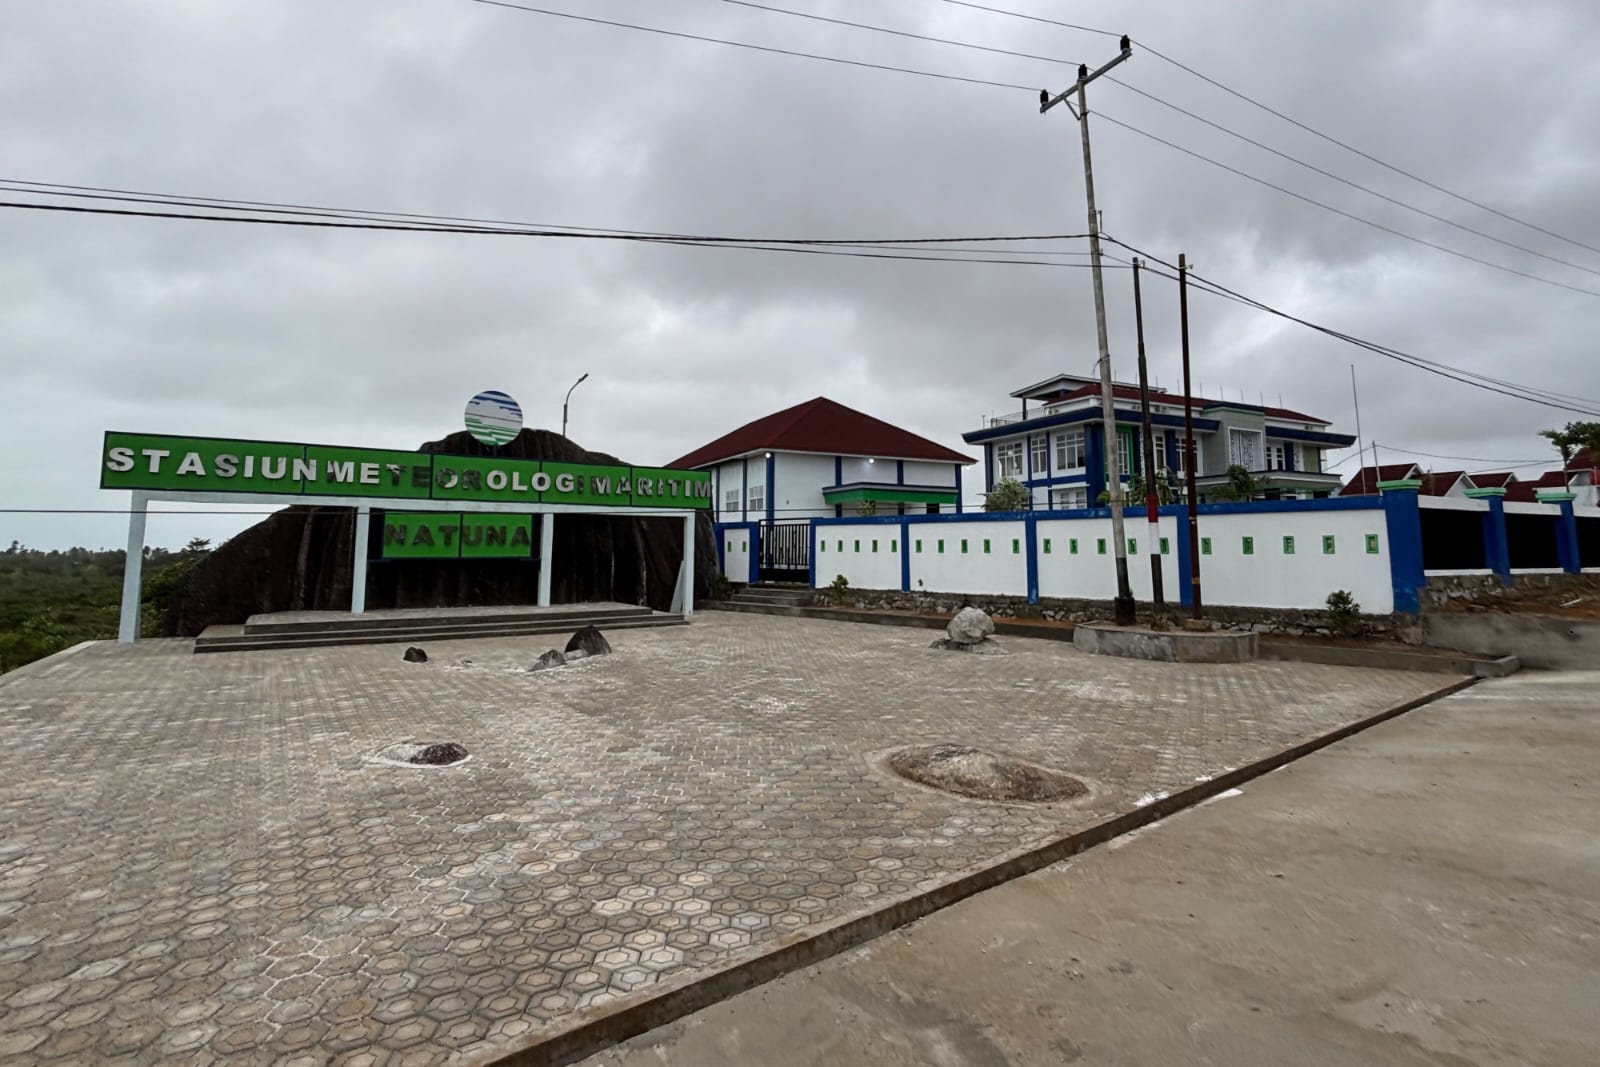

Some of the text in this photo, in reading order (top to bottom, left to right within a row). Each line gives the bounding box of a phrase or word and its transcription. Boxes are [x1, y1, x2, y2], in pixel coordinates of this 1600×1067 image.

[106, 447, 712, 498] STASIUN METEOROLOGI MARITIM
[384, 523, 530, 546] NATUNA
